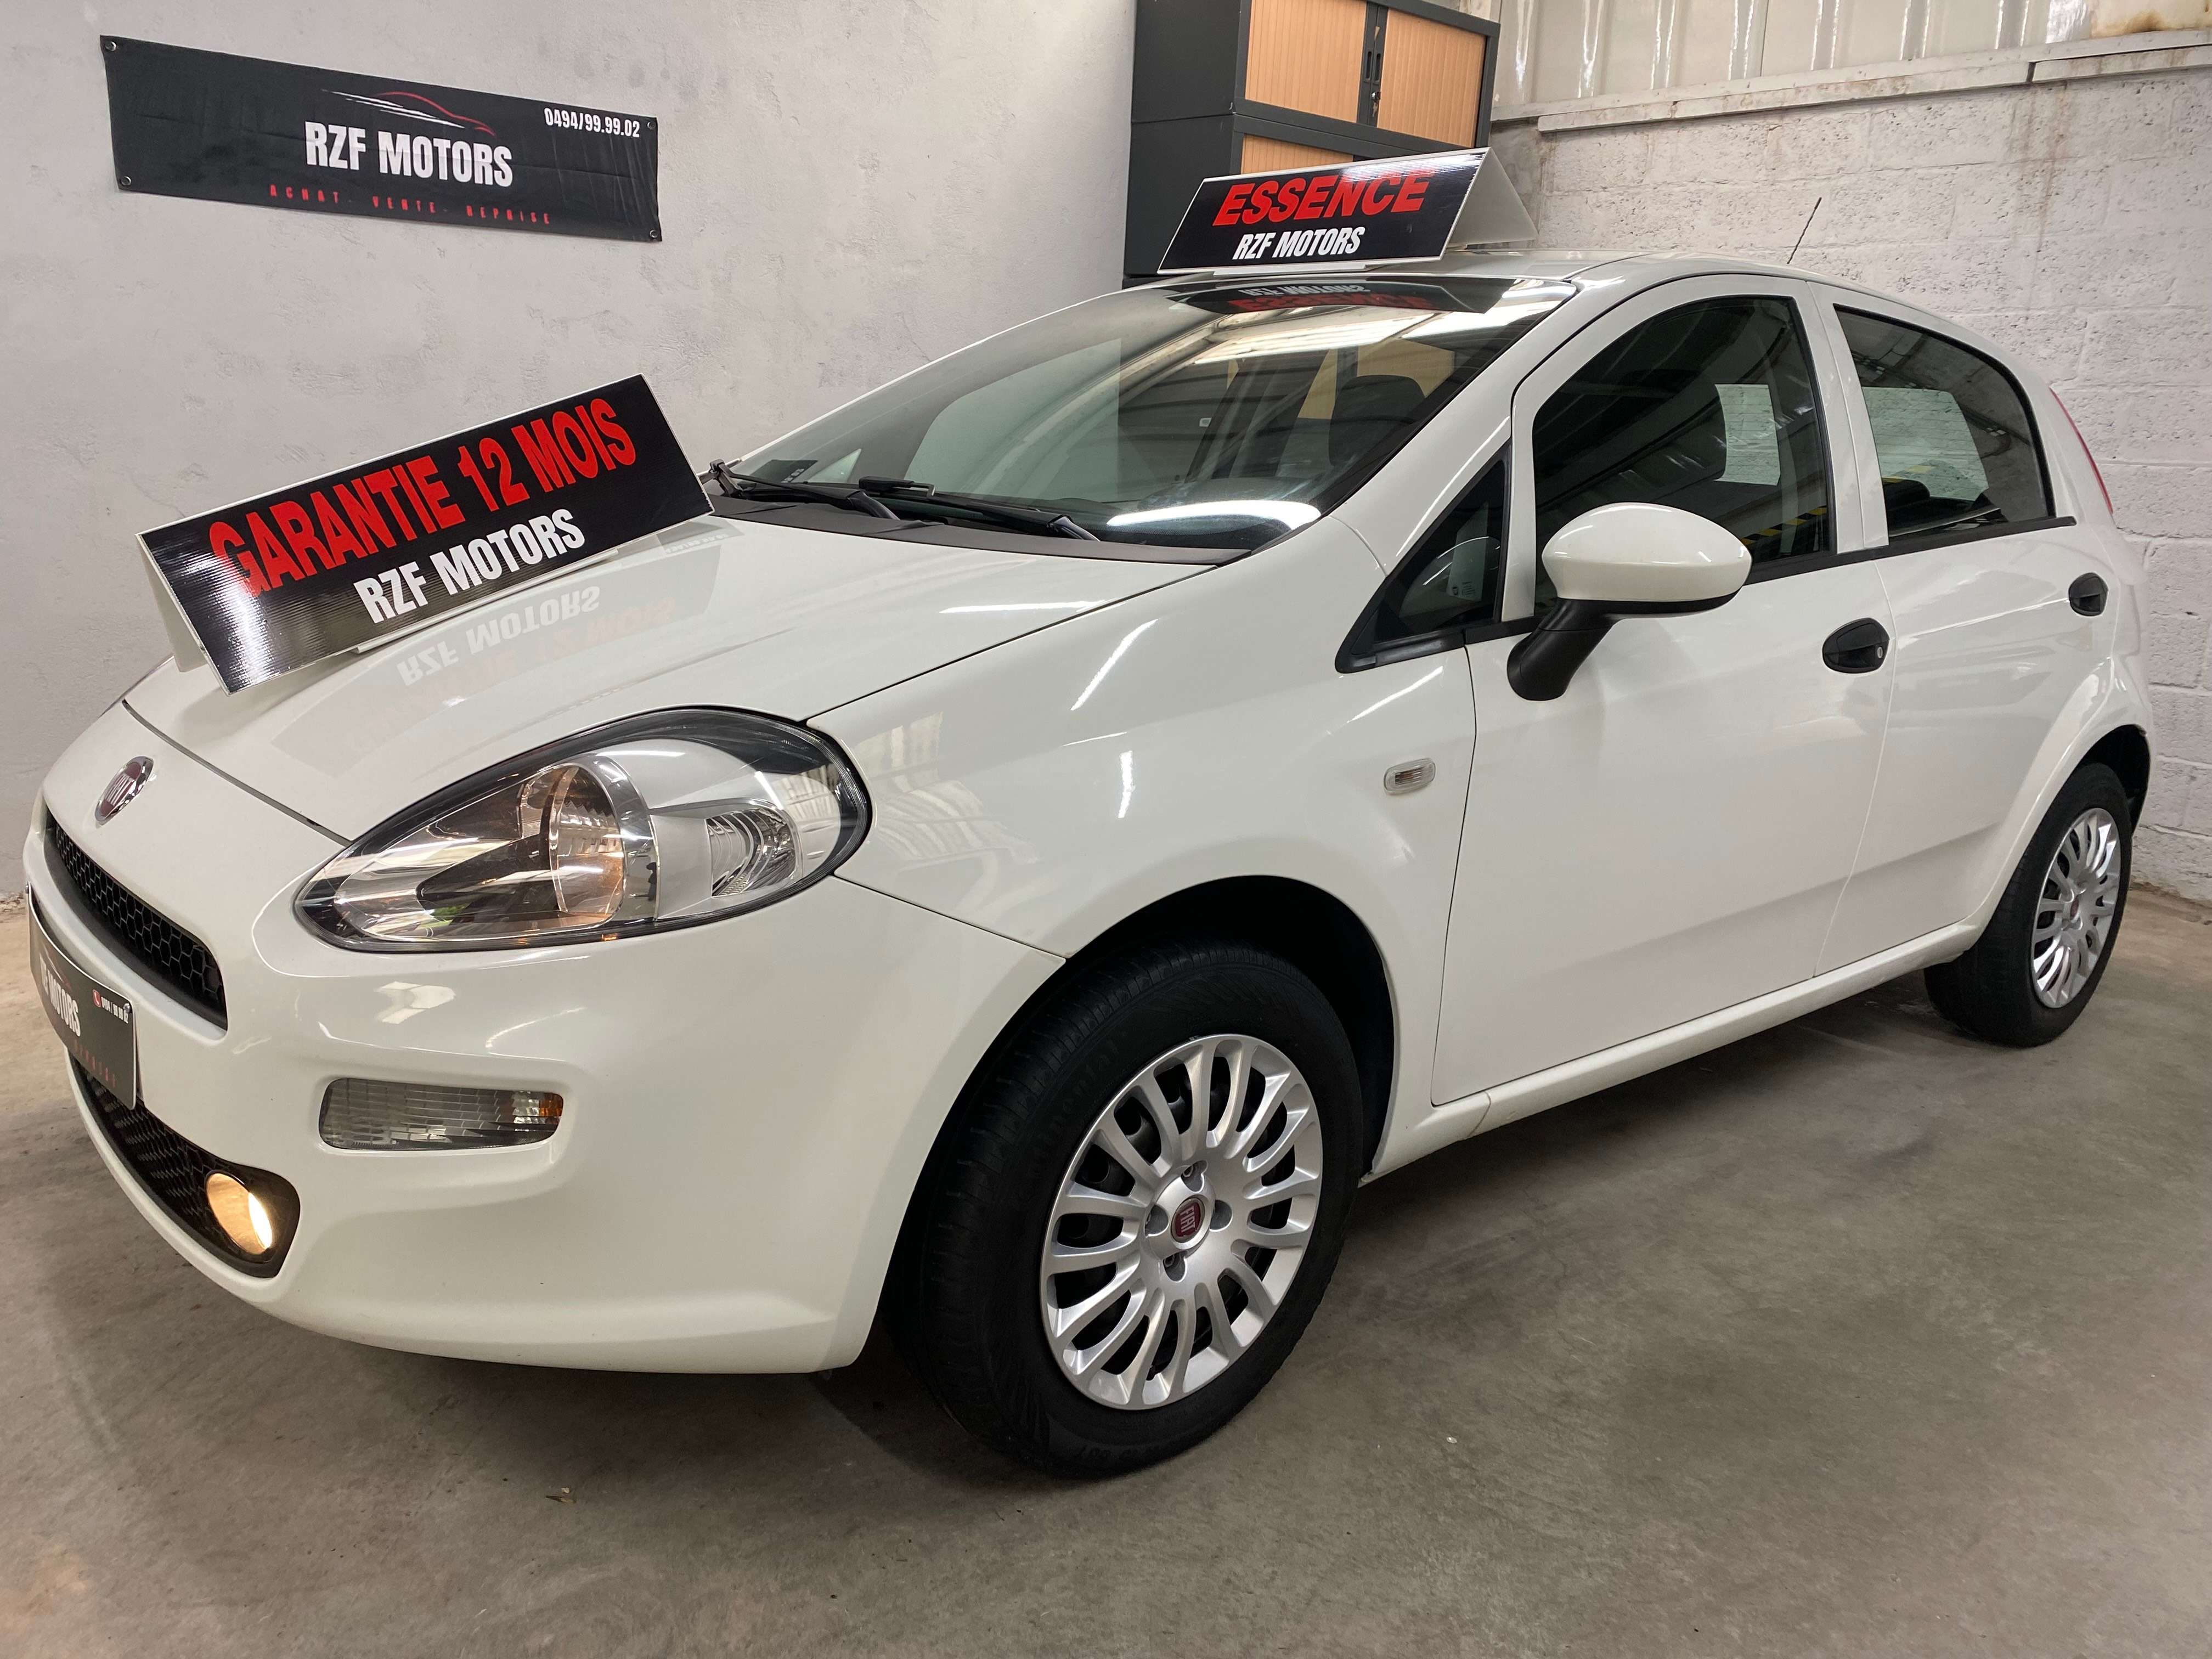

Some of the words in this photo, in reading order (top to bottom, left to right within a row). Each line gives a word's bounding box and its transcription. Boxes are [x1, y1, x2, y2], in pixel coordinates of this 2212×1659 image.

[543, 108, 640, 138] 0494/99.99.02
[304, 121, 366, 171] RZF
[377, 131, 513, 187] MOTORS
[269, 184, 339, 204] ACHAT
[1212, 167, 1438, 226] ESSENCE
[1232, 232, 1277, 260] RZF
[1272, 227, 1365, 258] MOTORS
[209, 455, 466, 598] GARANTIE
[458, 437, 529, 512] 12
[511, 398, 636, 493] MOIS
[353, 564, 427, 624] RZF
[430, 509, 586, 596] MOTORS
[1180, 1205, 1196, 1233] FIAT
